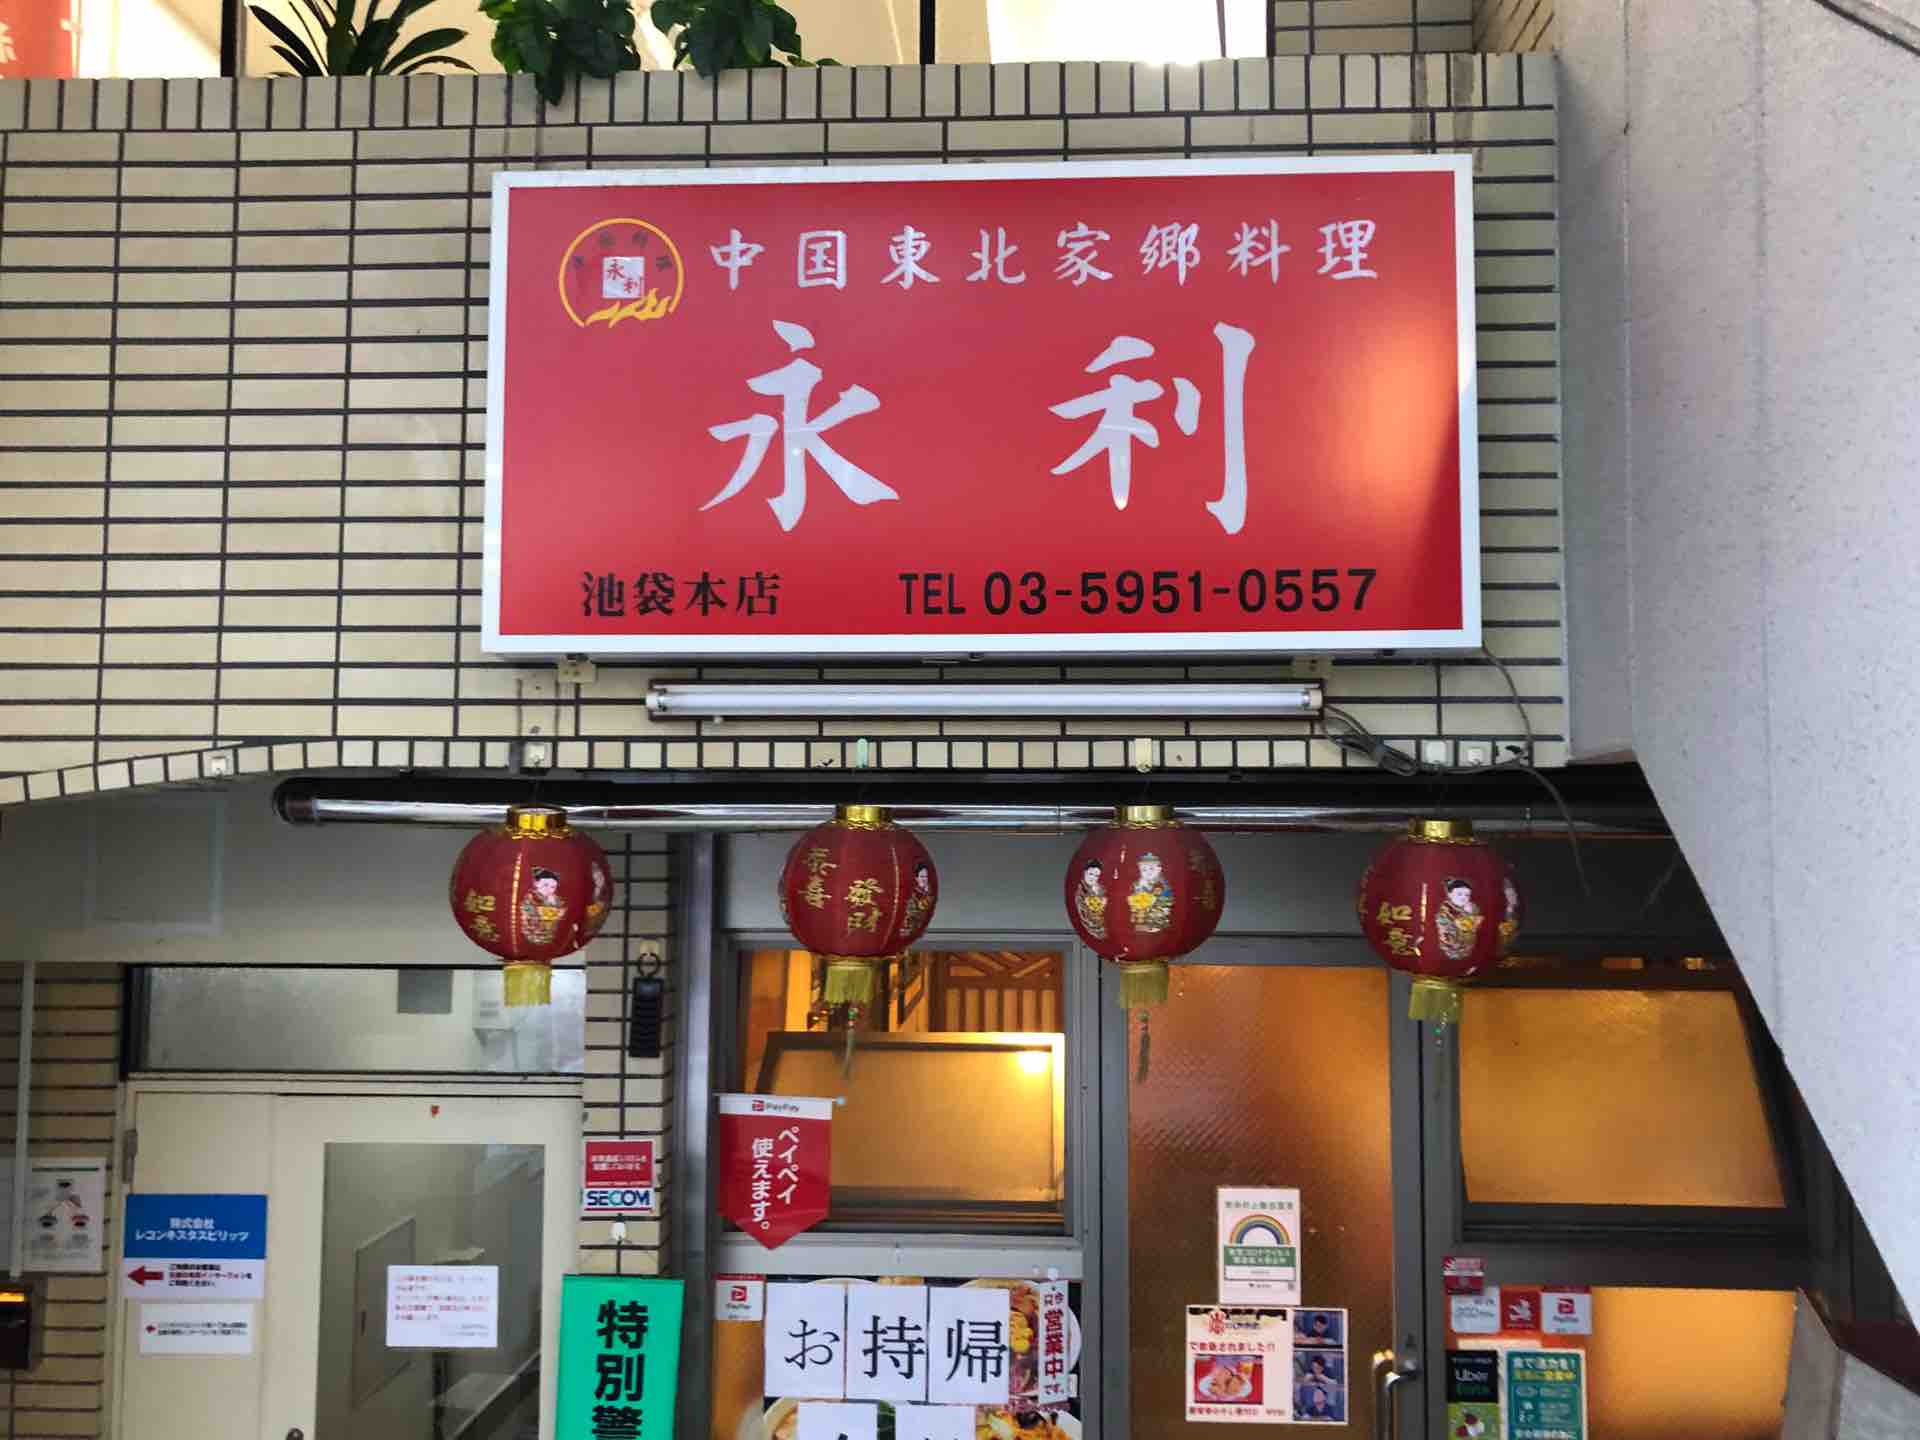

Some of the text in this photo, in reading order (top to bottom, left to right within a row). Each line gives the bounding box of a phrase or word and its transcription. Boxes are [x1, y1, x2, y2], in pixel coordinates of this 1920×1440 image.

[709, 218, 1380, 292] 中国東北家郷料理
[698, 319, 1256, 535] 永利
[580, 570, 780, 619] 池袋本店
[899, 567, 1378, 616] TEL 03-5951-0557
[587, 1190, 650, 1206] SECOM
[750, 1138, 773, 1230] 使えます。
[778, 1126, 800, 1204] ペイペイ
